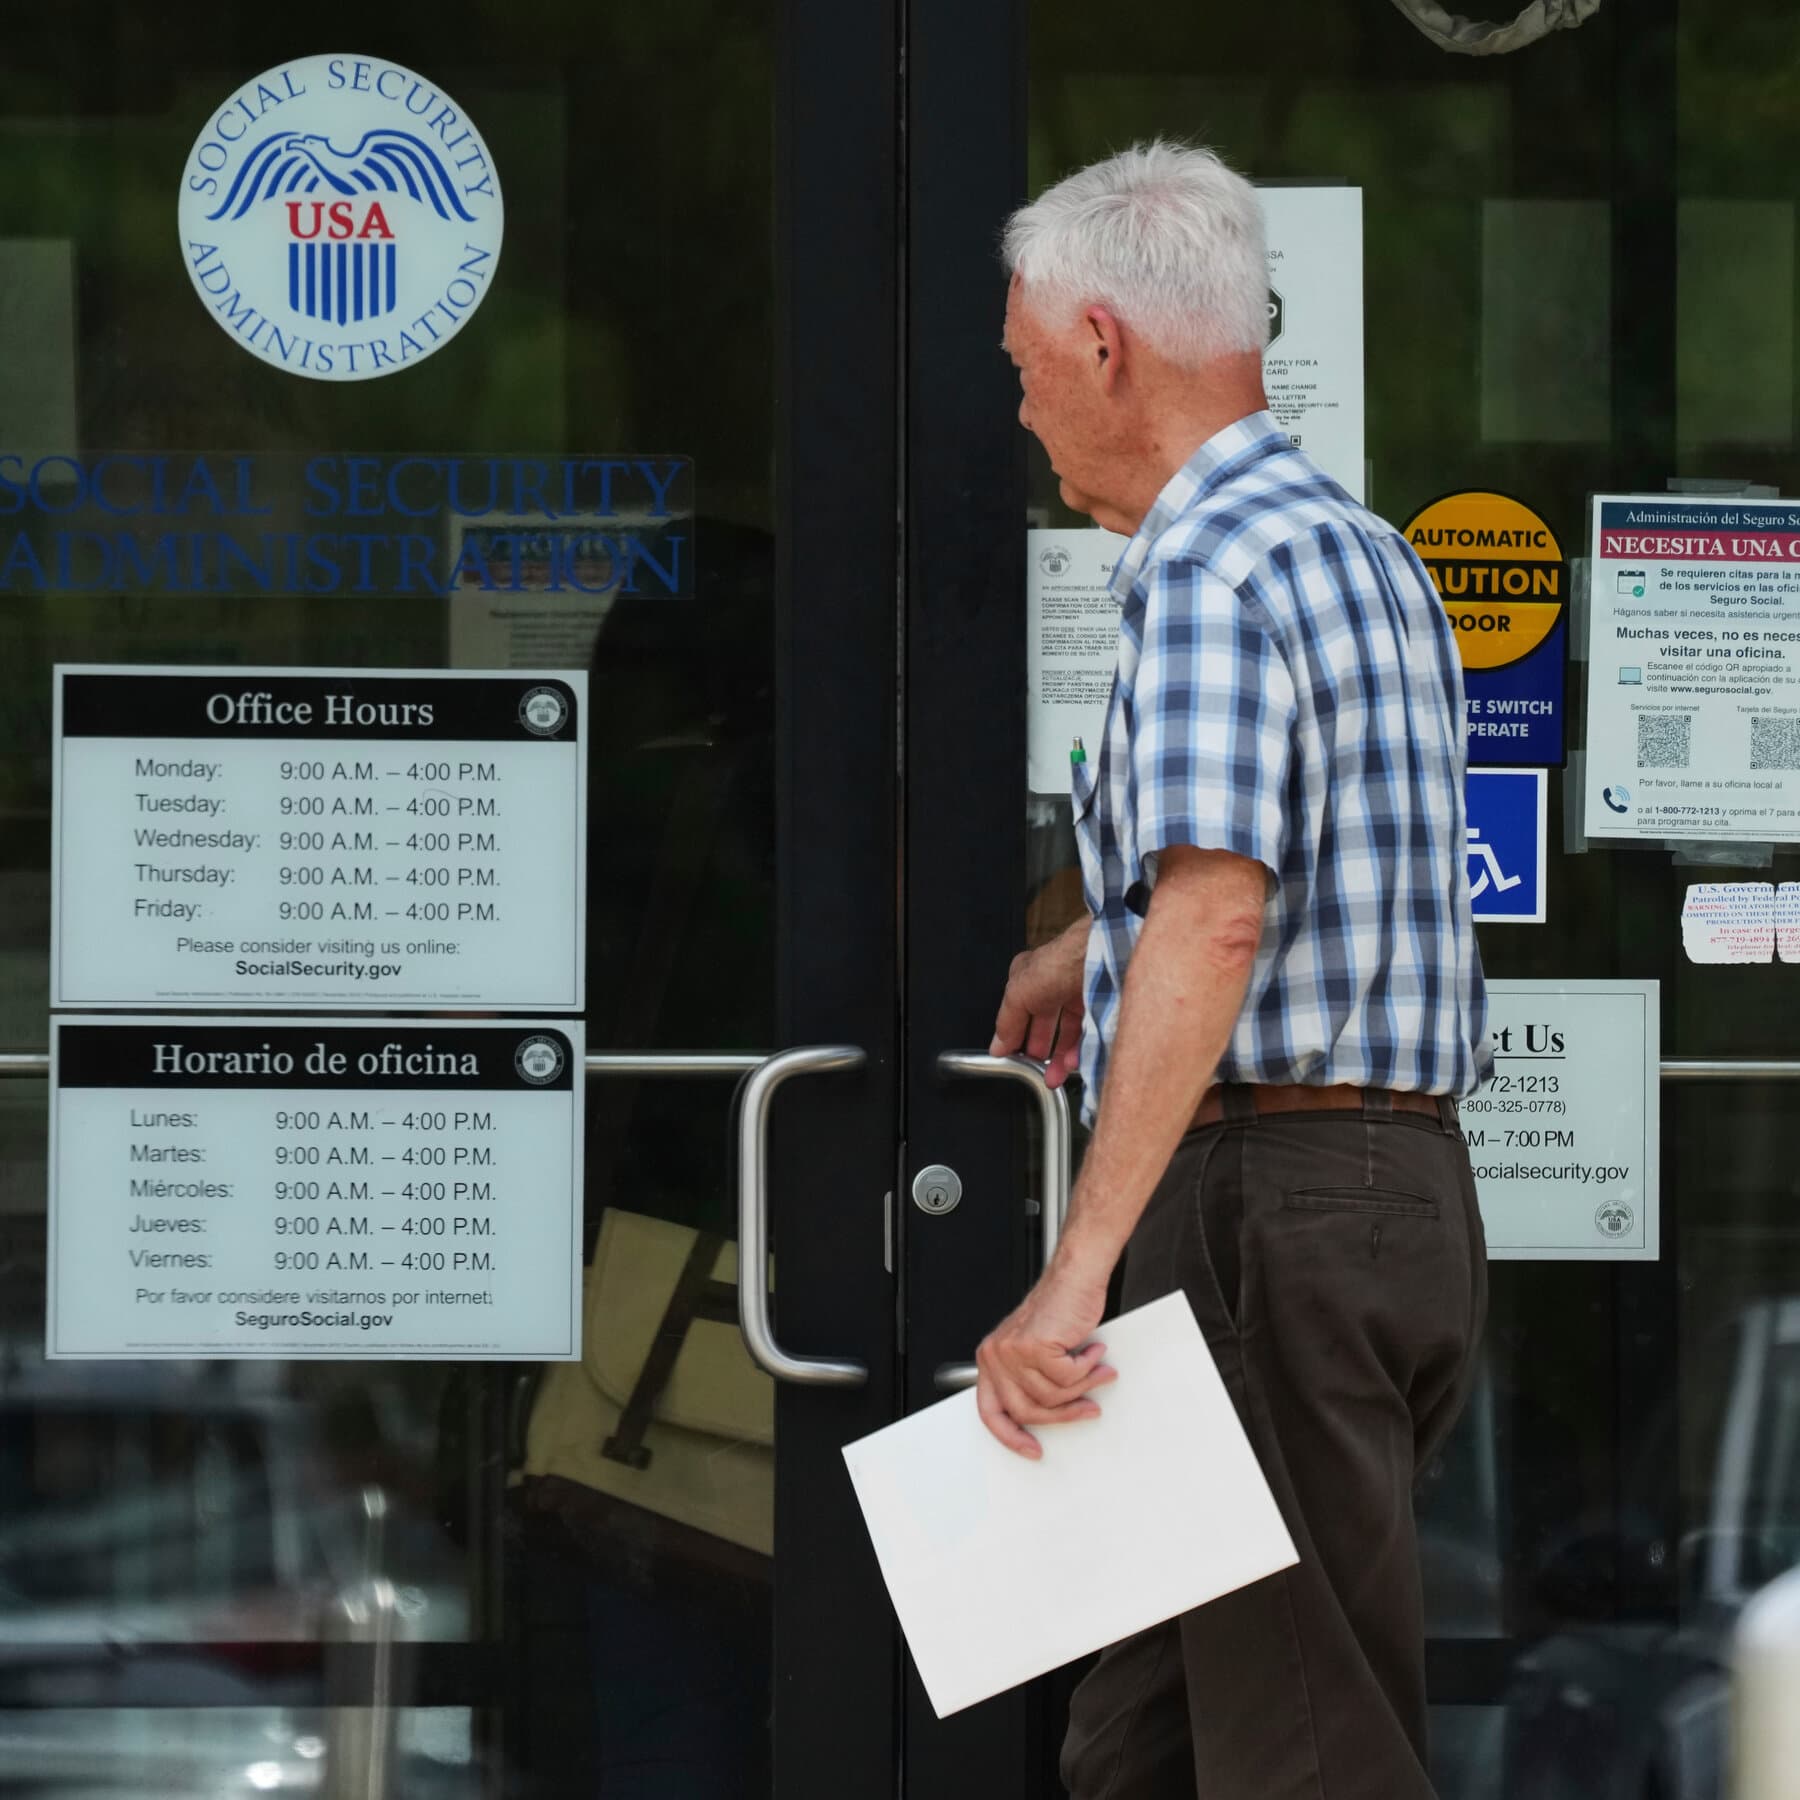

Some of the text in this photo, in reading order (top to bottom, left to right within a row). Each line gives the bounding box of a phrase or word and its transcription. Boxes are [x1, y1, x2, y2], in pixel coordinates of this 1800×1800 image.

[189, 59, 495, 198] SOCIAL SECURITY
[285, 201, 395, 240] USA
[187, 239, 492, 373] ADMINISTRATION
[0, 455, 687, 520] SOCIAL SECURITY
[1625, 511, 1718, 524] Administración
[1721, 512, 1739, 525] del
[1743, 513, 1785, 528] Seguro
[1411, 528, 1547, 548] AUTOMATIC
[1606, 536, 1726, 556] NECESITA
[1732, 539, 1784, 557] UNA
[0, 530, 687, 593] ADMINISTRATION
[1427, 566, 1558, 595] AUTION
[1660, 568, 1673, 578] Se
[1677, 568, 1726, 581] requieren
[1729, 569, 1753, 579] citas
[1757, 571, 1779, 582] para
[1783, 571, 1791, 581] la
[1660, 581, 1672, 590] de
[1675, 581, 1690, 591] los
[1694, 581, 1740, 592] servicios
[1759, 582, 1773, 592] las
[1710, 595, 1785, 608] Seguro Social.
[1616, 626, 1670, 640] Muchas
[1674, 630, 1718, 642] veces,
[1722, 631, 1739, 641] no
[1743, 631, 1759, 641] es
[1660, 645, 1786, 660] visitar una oficina.
[1647, 661, 1783, 675] Escanee el código QR apropiado
[1646, 673, 1796, 686] continuación con la aplicación de su
[1646, 684, 1668, 693] visite
[206, 692, 434, 726] Office Hours
[1487, 700, 1553, 714] SWITCH
[1467, 722, 1529, 737] PERATE
[136, 758, 500, 782] Monday: 9:00 A.M. 4:00 P.M.
[1639, 778, 1653, 787] Por
[1681, 779, 1703, 788] llame
[1725, 779, 1751, 789] oficina
[1754, 781, 1772, 790] local
[1775, 781, 1783, 790] al
[136, 794, 500, 817] Tuesday: 9:00 A.M. 4:00 P.M.
[1655, 806, 1720, 816] 1-800-772-1213
[1729, 808, 1757, 818] oprima
[134, 829, 500, 852] Wednesday: 9:00 A.M. 4:00 P.M.
[134, 864, 499, 887] Thursday: 9:00 A.M. 4:00 P.M.
[135, 899, 499, 922] Friday: 9:00 A.M. 4:00 P.M.
[177, 937, 460, 958] Please consider visiting us online:
[236, 960, 402, 980] SocialSecurity.gov
[1524, 1024, 1565, 1053] Us
[153, 1043, 293, 1074] Horario
[305, 1043, 346, 1075] de
[358, 1043, 479, 1076] oficina
[1489, 1076, 1559, 1093] 72-1213
[131, 1110, 496, 1130] Lunes: 9:00 A.M. 4:00 P.M.
[1503, 1131, 1540, 1147] 7:00
[1545, 1131, 1574, 1147] PM
[131, 1144, 496, 1165] Martes: 9:00 A.M. 4:00 P.M.
[1472, 1163, 1629, 1184] socialsecurity.gov
[131, 1180, 496, 1200] Miércoles: 9:00 A.M. 4:00 P.M.
[130, 1215, 495, 1236] Jueves: 9:00 A.M. 4:00 P.M.
[129, 1250, 495, 1270] Viernes: 9:00 A.M. 4:00 P.M.
[136, 1289, 493, 1308] Por favor considere visitarnos por internet:
[236, 1311, 393, 1331] SeguroSocial.gov
